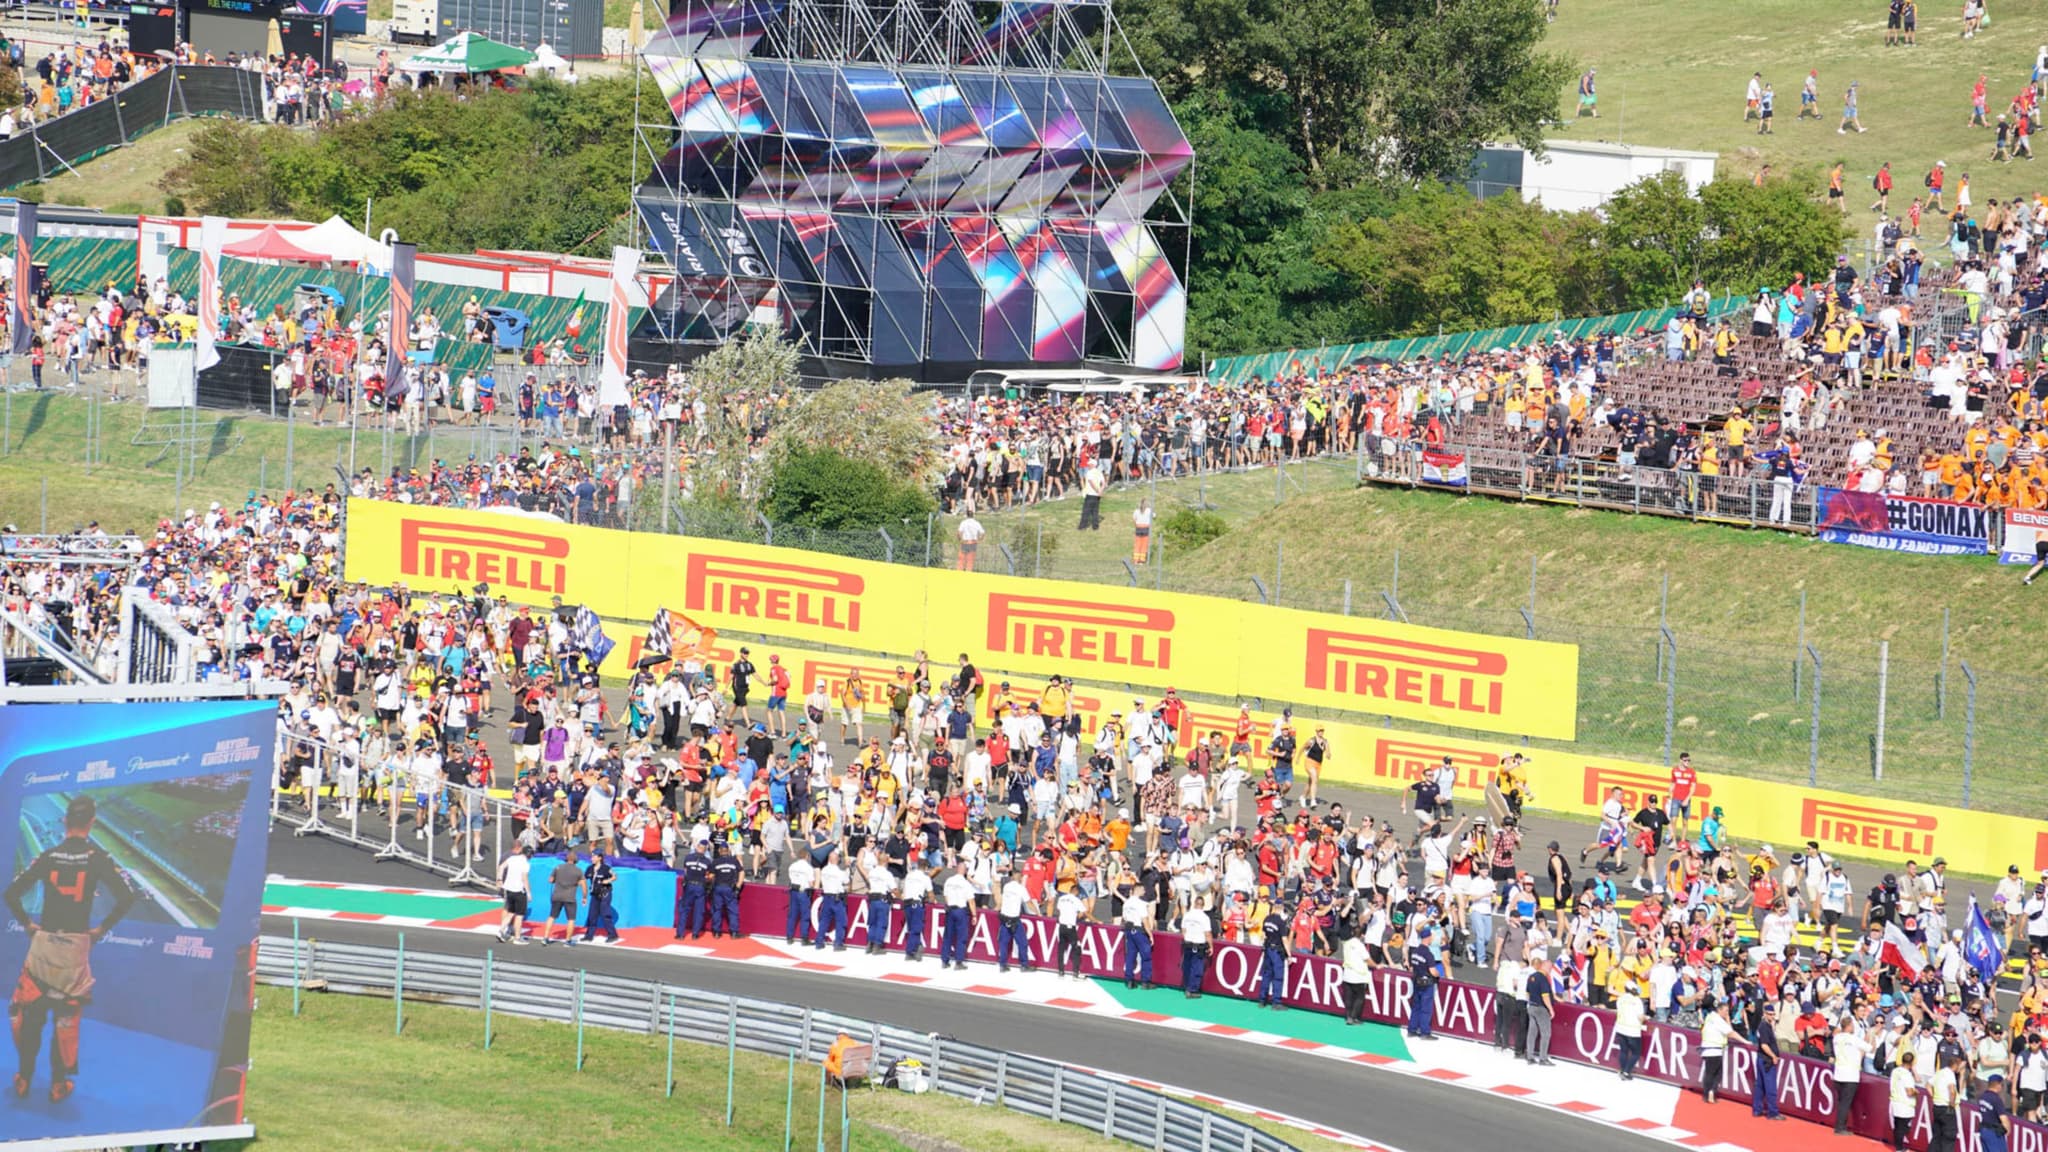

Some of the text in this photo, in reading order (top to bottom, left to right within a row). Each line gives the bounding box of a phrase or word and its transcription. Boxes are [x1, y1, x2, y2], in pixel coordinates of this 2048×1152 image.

[1887, 500, 1987, 538] #GOMAX
[400, 518, 570, 594] PIRELLI
[685, 552, 865, 632] PIRELLI
[987, 592, 1175, 670] PIRELLI
[1304, 628, 1508, 715] PIRELLI
[125, 752, 190, 775] Paramount+
[1801, 798, 1938, 856] PIRELLI
[50, 871, 86, 902] 4
